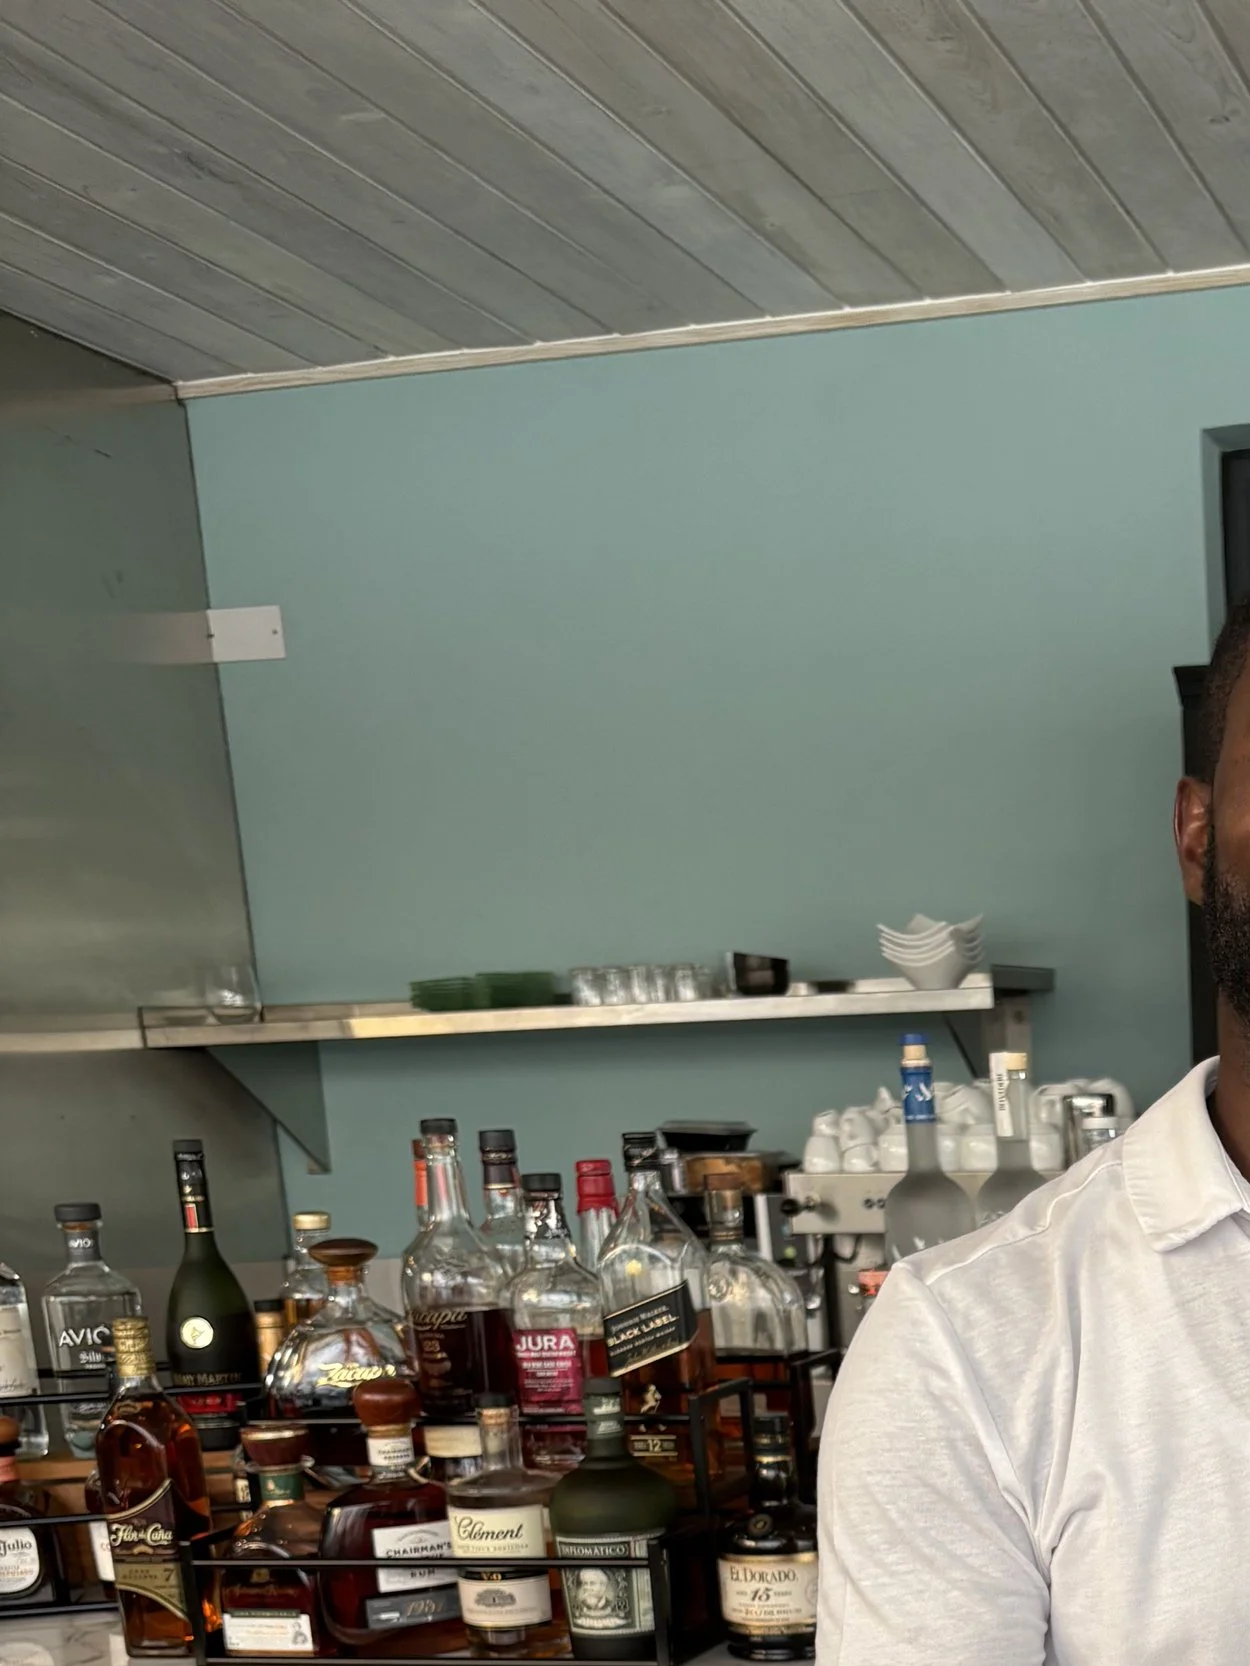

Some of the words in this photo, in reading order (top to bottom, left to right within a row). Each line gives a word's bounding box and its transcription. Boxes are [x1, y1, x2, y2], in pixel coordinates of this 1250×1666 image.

[515, 1334, 575, 1351] JURA
[606, 1326, 642, 1347] BLACK
[647, 1439, 662, 1453] 12
[110, 1522, 139, 1546] Flor
[163, 1568, 174, 1582] 7
[743, 1566, 797, 1584] DORADO
[751, 1587, 773, 1602] 15
